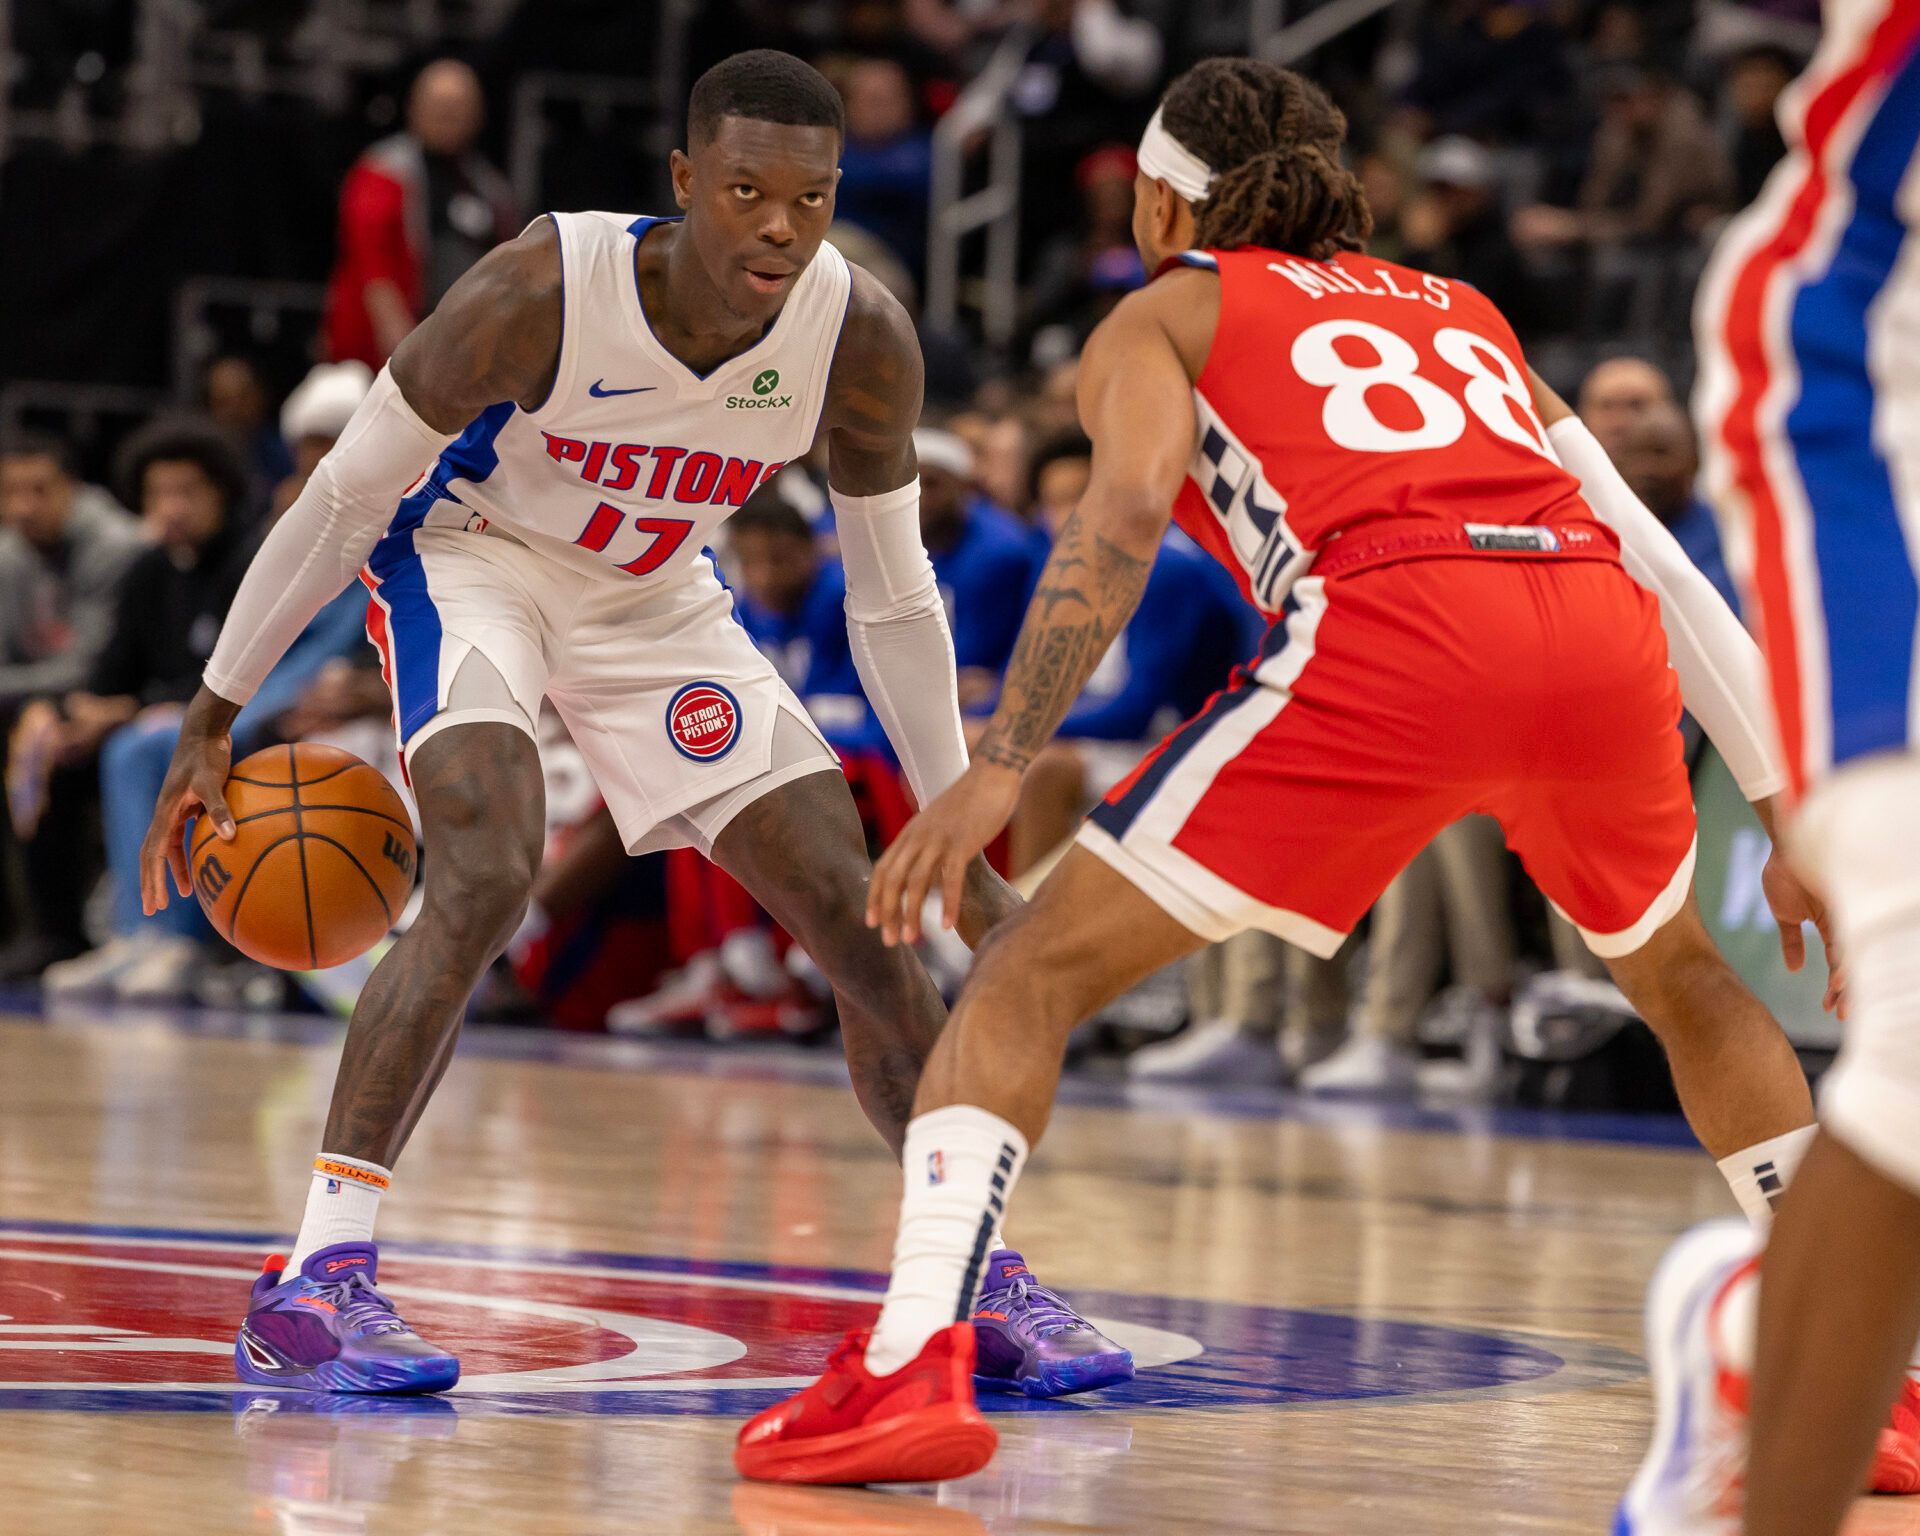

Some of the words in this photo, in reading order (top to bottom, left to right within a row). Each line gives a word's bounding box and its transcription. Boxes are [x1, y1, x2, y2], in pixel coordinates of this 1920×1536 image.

[1267, 259, 1450, 310] MILLS
[725, 395, 793, 409] StockX
[1290, 318, 1563, 468] 88
[572, 501, 696, 577] 17
[678, 702, 724, 729] DETROIT
[682, 715, 729, 741] PISTONS
